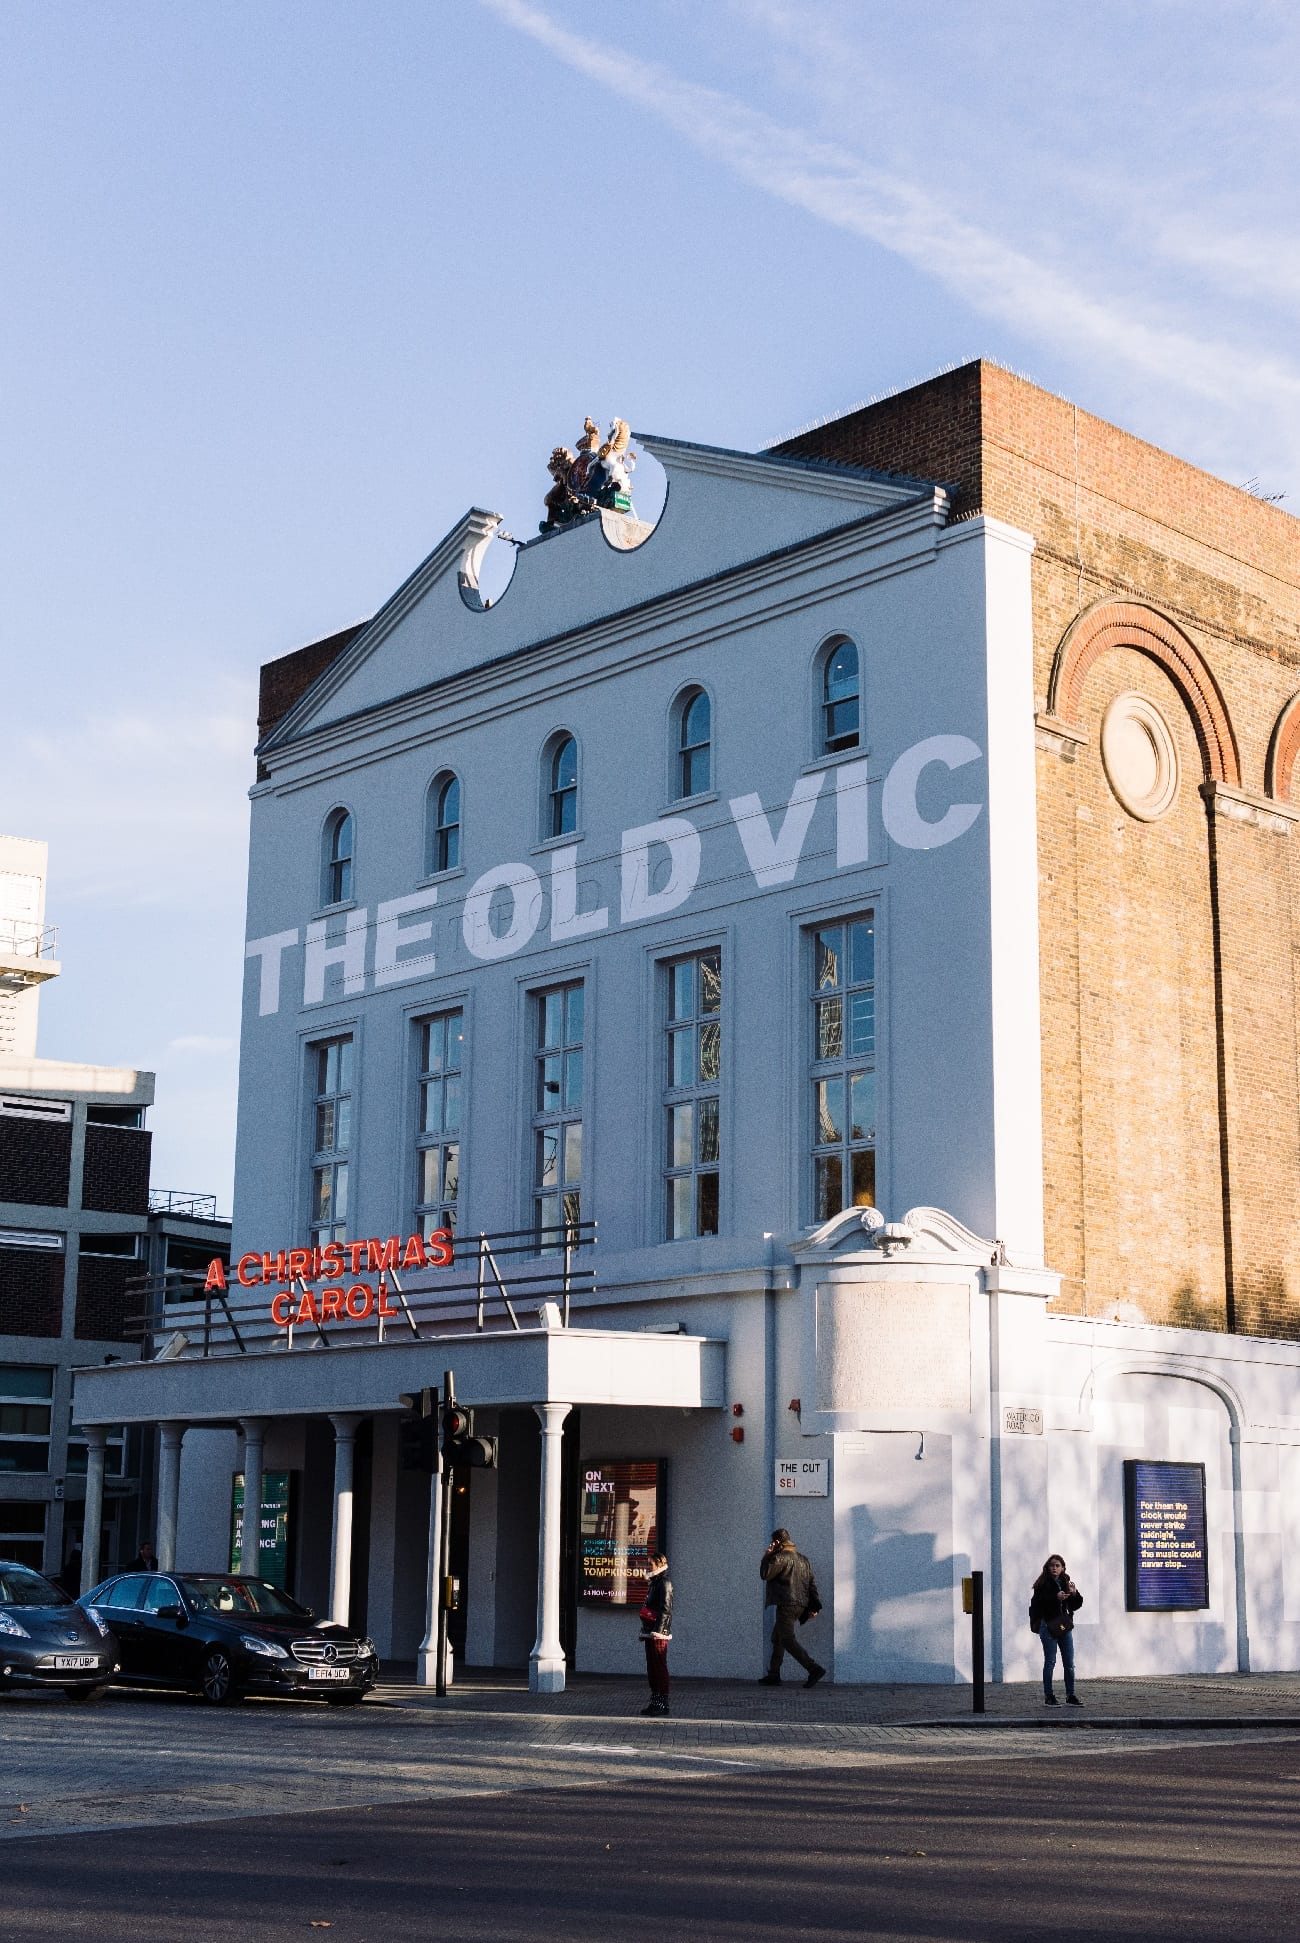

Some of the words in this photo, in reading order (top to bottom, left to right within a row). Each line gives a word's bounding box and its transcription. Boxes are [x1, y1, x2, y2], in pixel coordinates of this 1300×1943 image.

[244, 887, 438, 1017] THE
[462, 817, 701, 960] OLD
[728, 734, 983, 889] VIC
[529, 879, 601, 932] OLD
[204, 1257, 227, 1291] A
[237, 1227, 454, 1288] CHRISTMAS
[271, 1282, 398, 1327] CAROL
[1006, 1420, 1025, 1430] ROAD
[780, 1463, 798, 1473] THE
[802, 1463, 821, 1473] CUT
[585, 1470, 602, 1481] ON
[585, 1482, 615, 1493] NEXT
[779, 1478, 796, 1489] SE1
[1141, 1501, 1153, 1510] For
[1155, 1501, 1174, 1510] them
[1175, 1502, 1188, 1510] the
[1141, 1511, 1162, 1519] clock
[1164, 1512, 1187, 1520] would
[1164, 1521, 1186, 1529] strike
[1141, 1531, 1176, 1541] midnight,
[1141, 1540, 1154, 1549] the
[1155, 1540, 1180, 1549] dance
[1180, 1540, 1196, 1549] and
[1141, 1550, 1154, 1558] the
[1155, 1550, 1179, 1558] music
[1180, 1550, 1202, 1559] could
[583, 1557, 627, 1566] STEPHEN
[583, 1567, 647, 1577] TOMPKINSON
[79, 1657, 95, 1667] UBP
[315, 1669, 332, 1678] EF14
